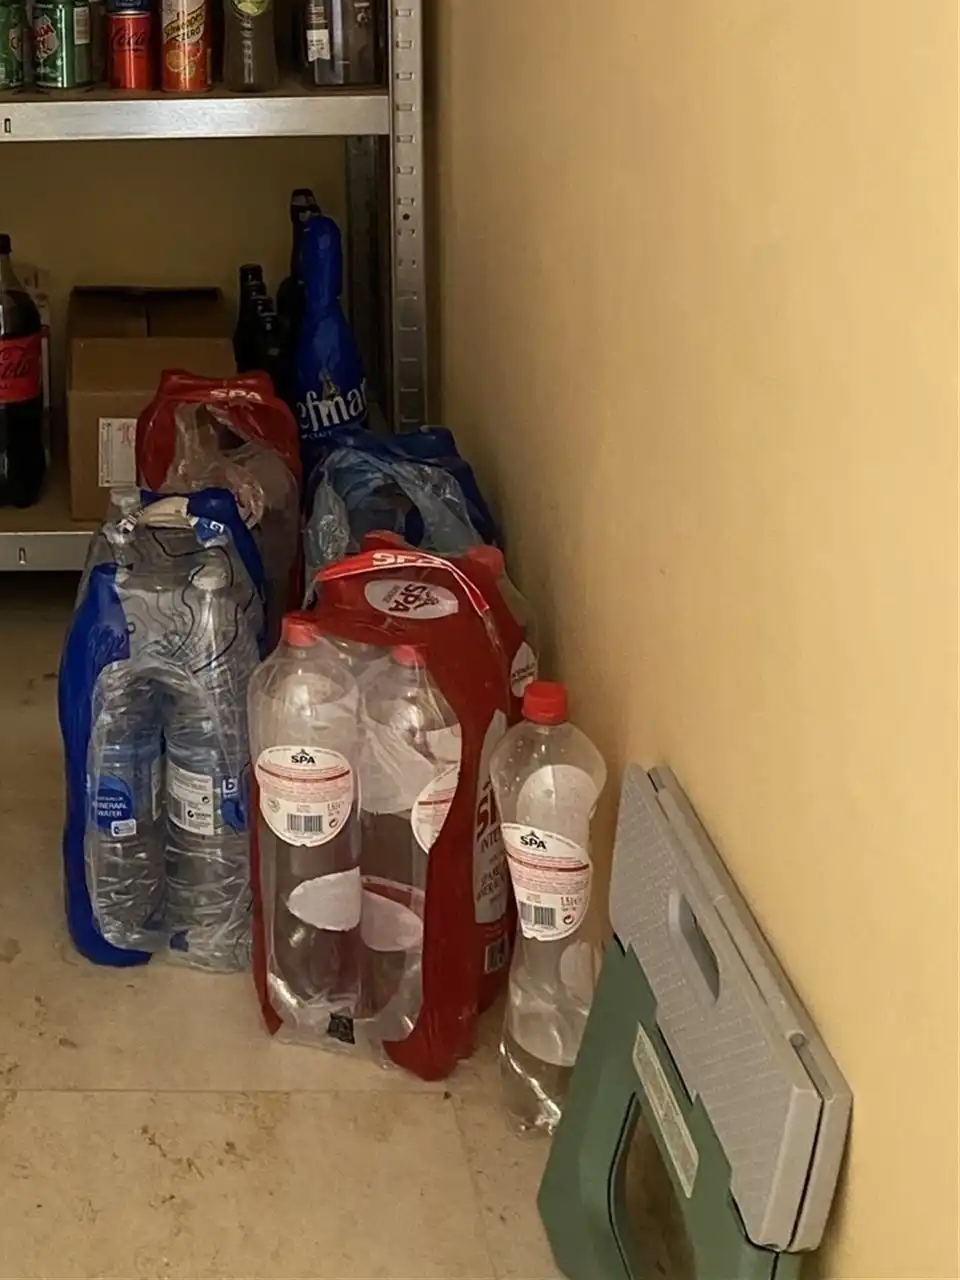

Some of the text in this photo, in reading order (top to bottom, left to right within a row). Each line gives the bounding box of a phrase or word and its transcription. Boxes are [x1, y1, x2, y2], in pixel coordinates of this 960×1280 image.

[209, 388, 263, 402] SPA
[388, 583, 428, 613] SPA
[291, 755, 316, 764] SPA
[97, 809, 123, 818] WATER
[520, 835, 547, 850] SPA
